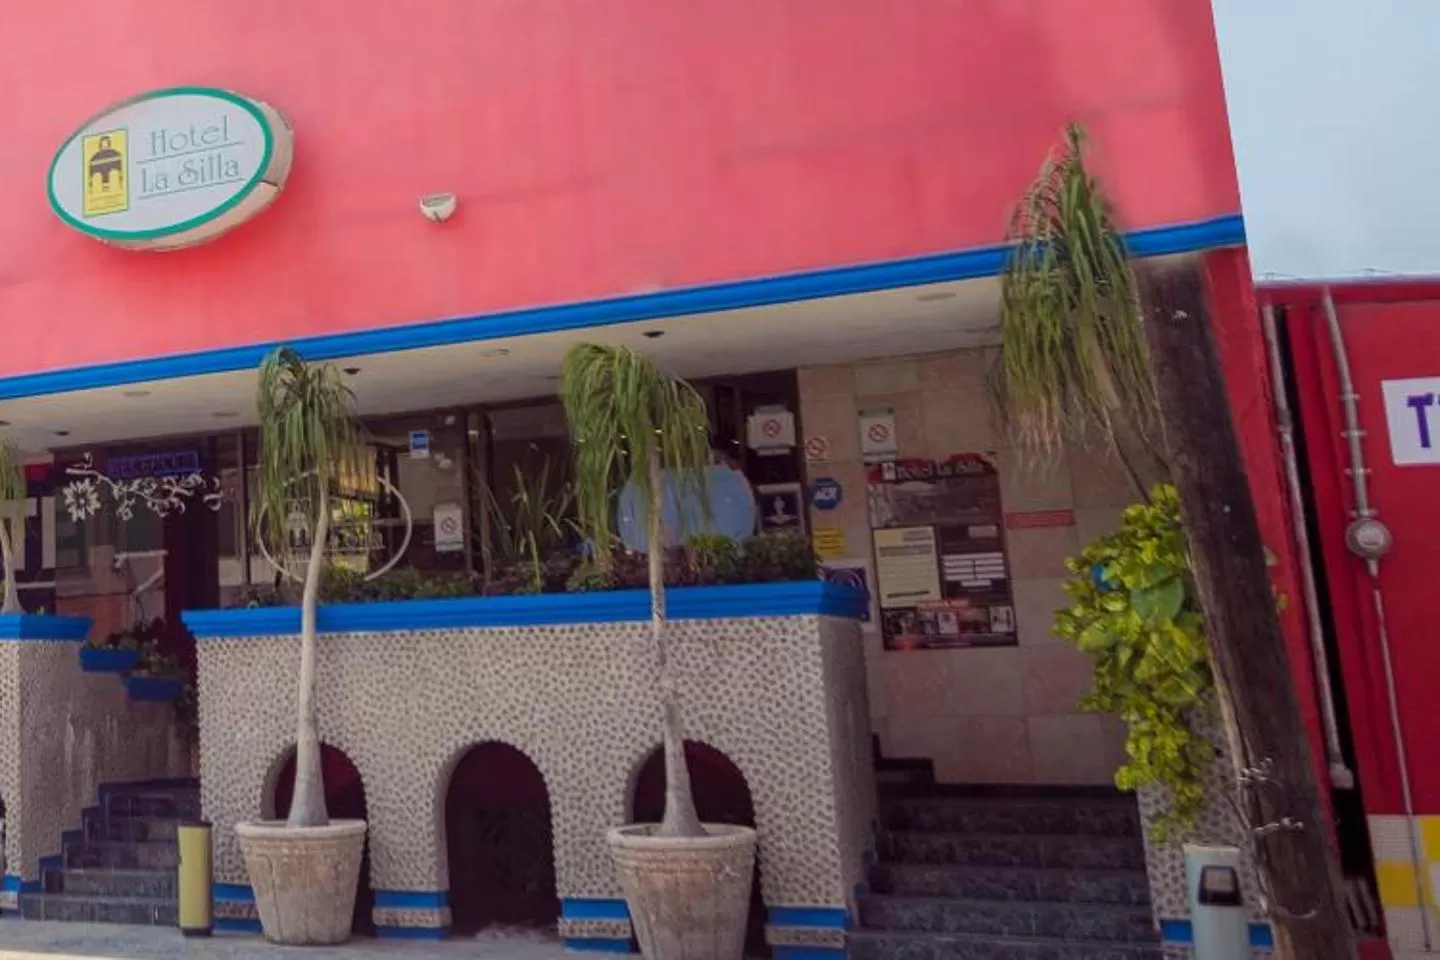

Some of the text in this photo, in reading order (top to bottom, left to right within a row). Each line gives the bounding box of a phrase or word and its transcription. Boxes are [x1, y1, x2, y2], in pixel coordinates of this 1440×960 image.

[152, 115, 229, 156] Hotel
[142, 153, 241, 193] La Silla
